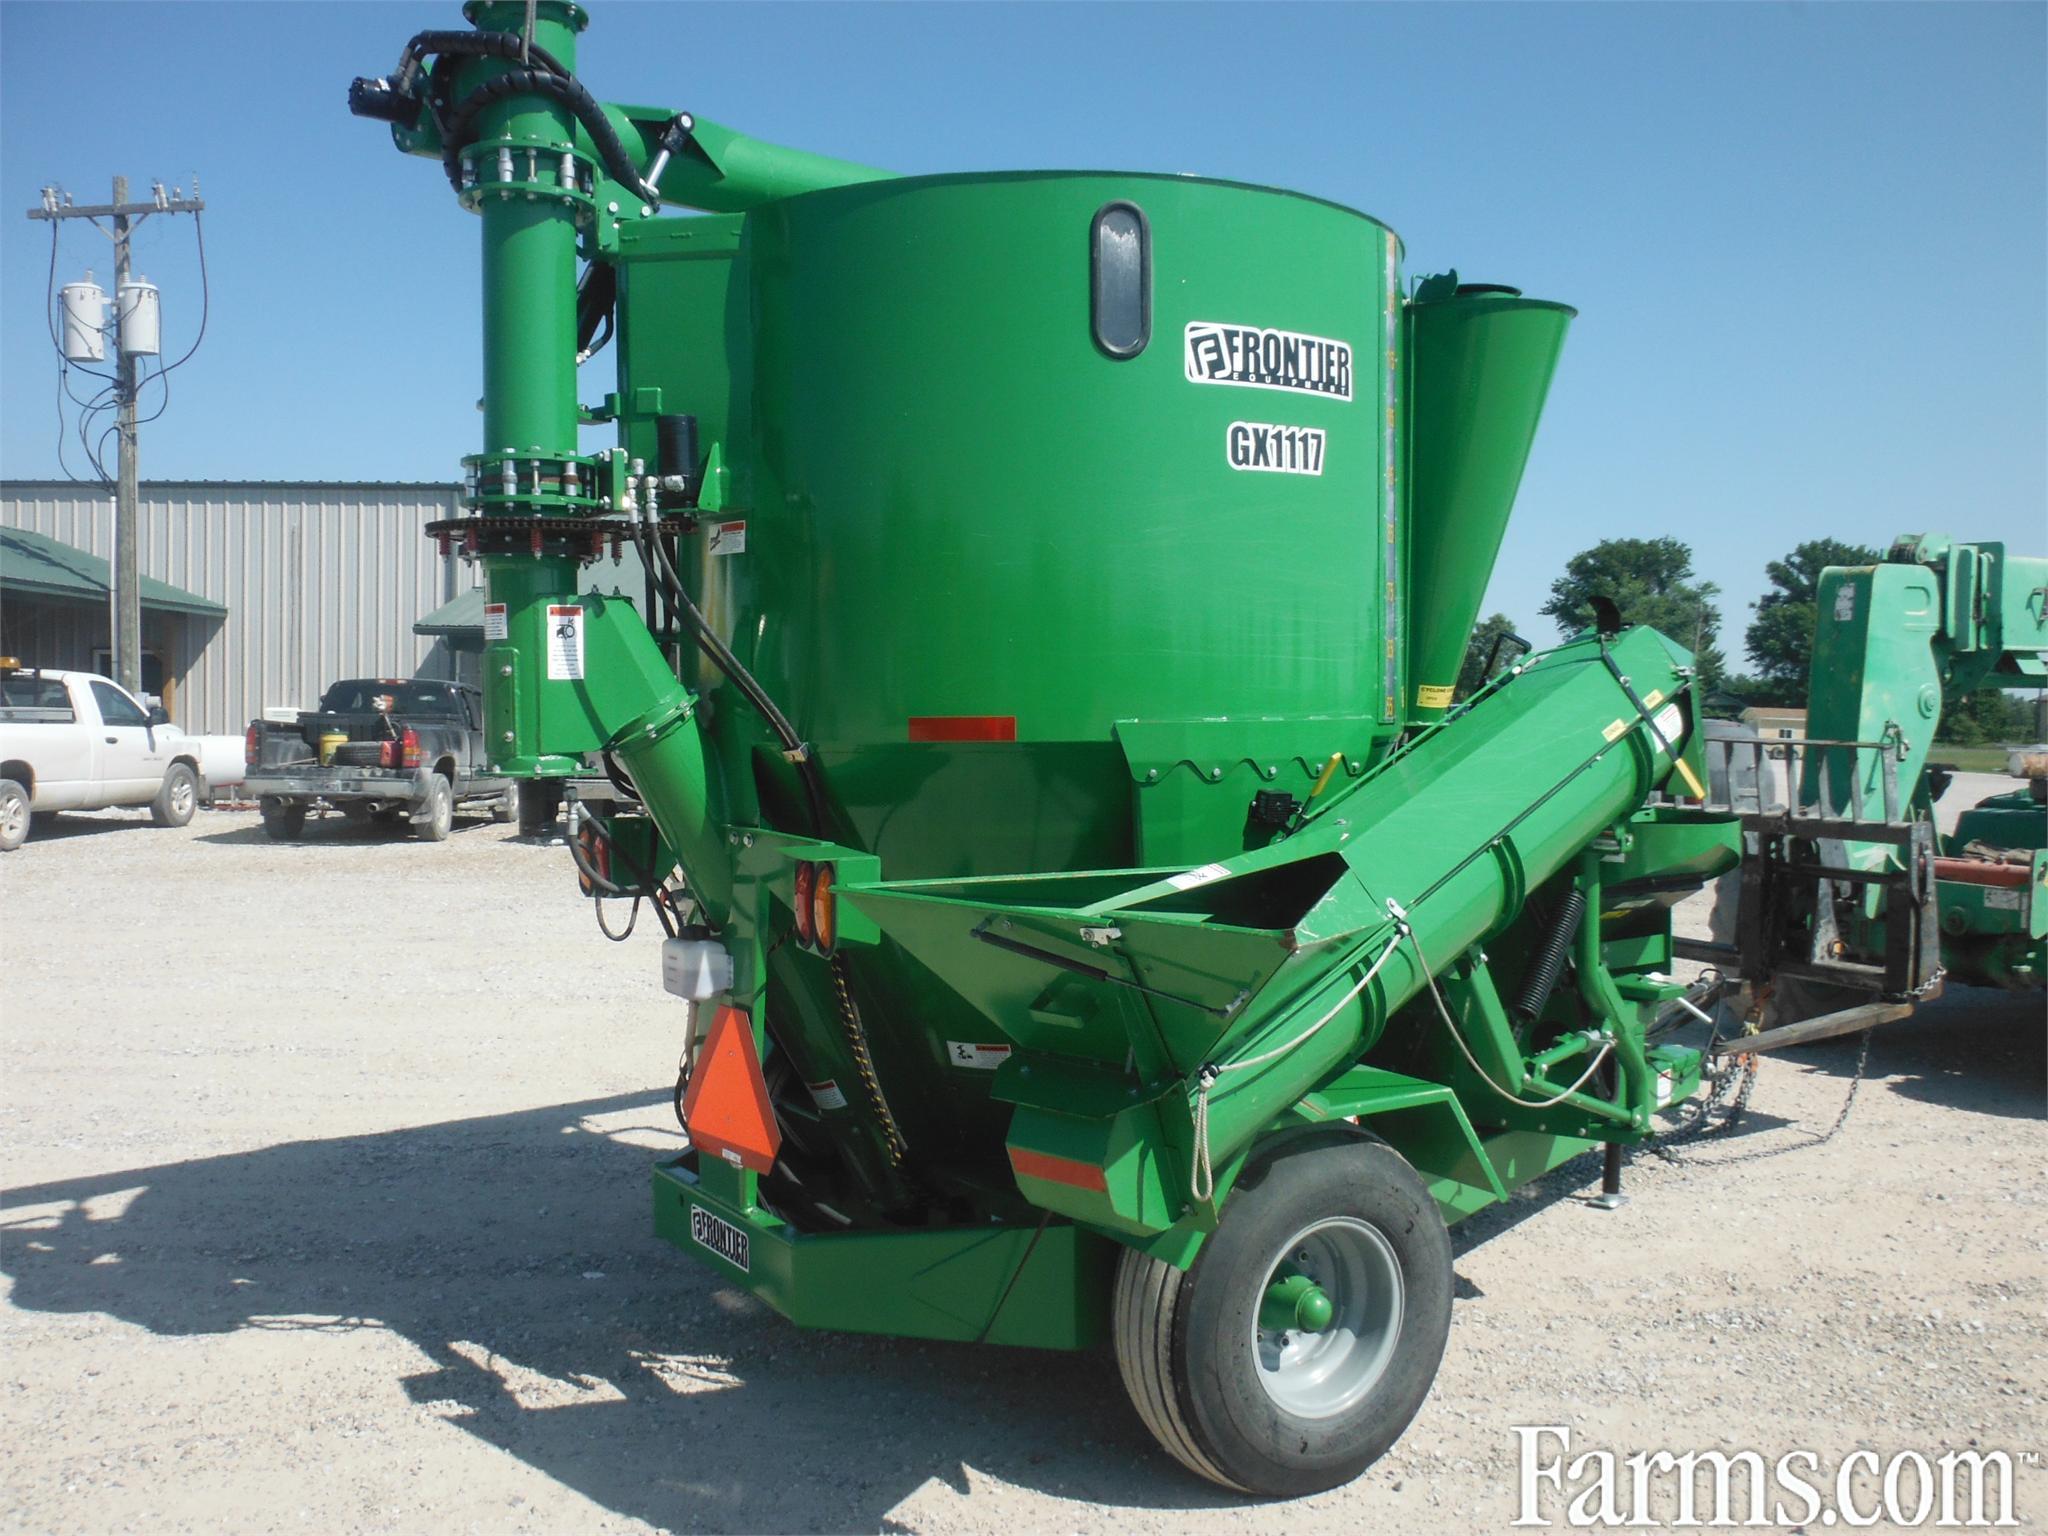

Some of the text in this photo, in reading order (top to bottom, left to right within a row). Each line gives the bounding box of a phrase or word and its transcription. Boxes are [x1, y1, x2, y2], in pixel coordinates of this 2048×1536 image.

[1223, 329, 1349, 386] FRONTIER
[1232, 372, 1347, 395] EQUIPMENT
[1230, 426, 1322, 471] GX1117
[701, 1211, 748, 1266] FRONTIER
